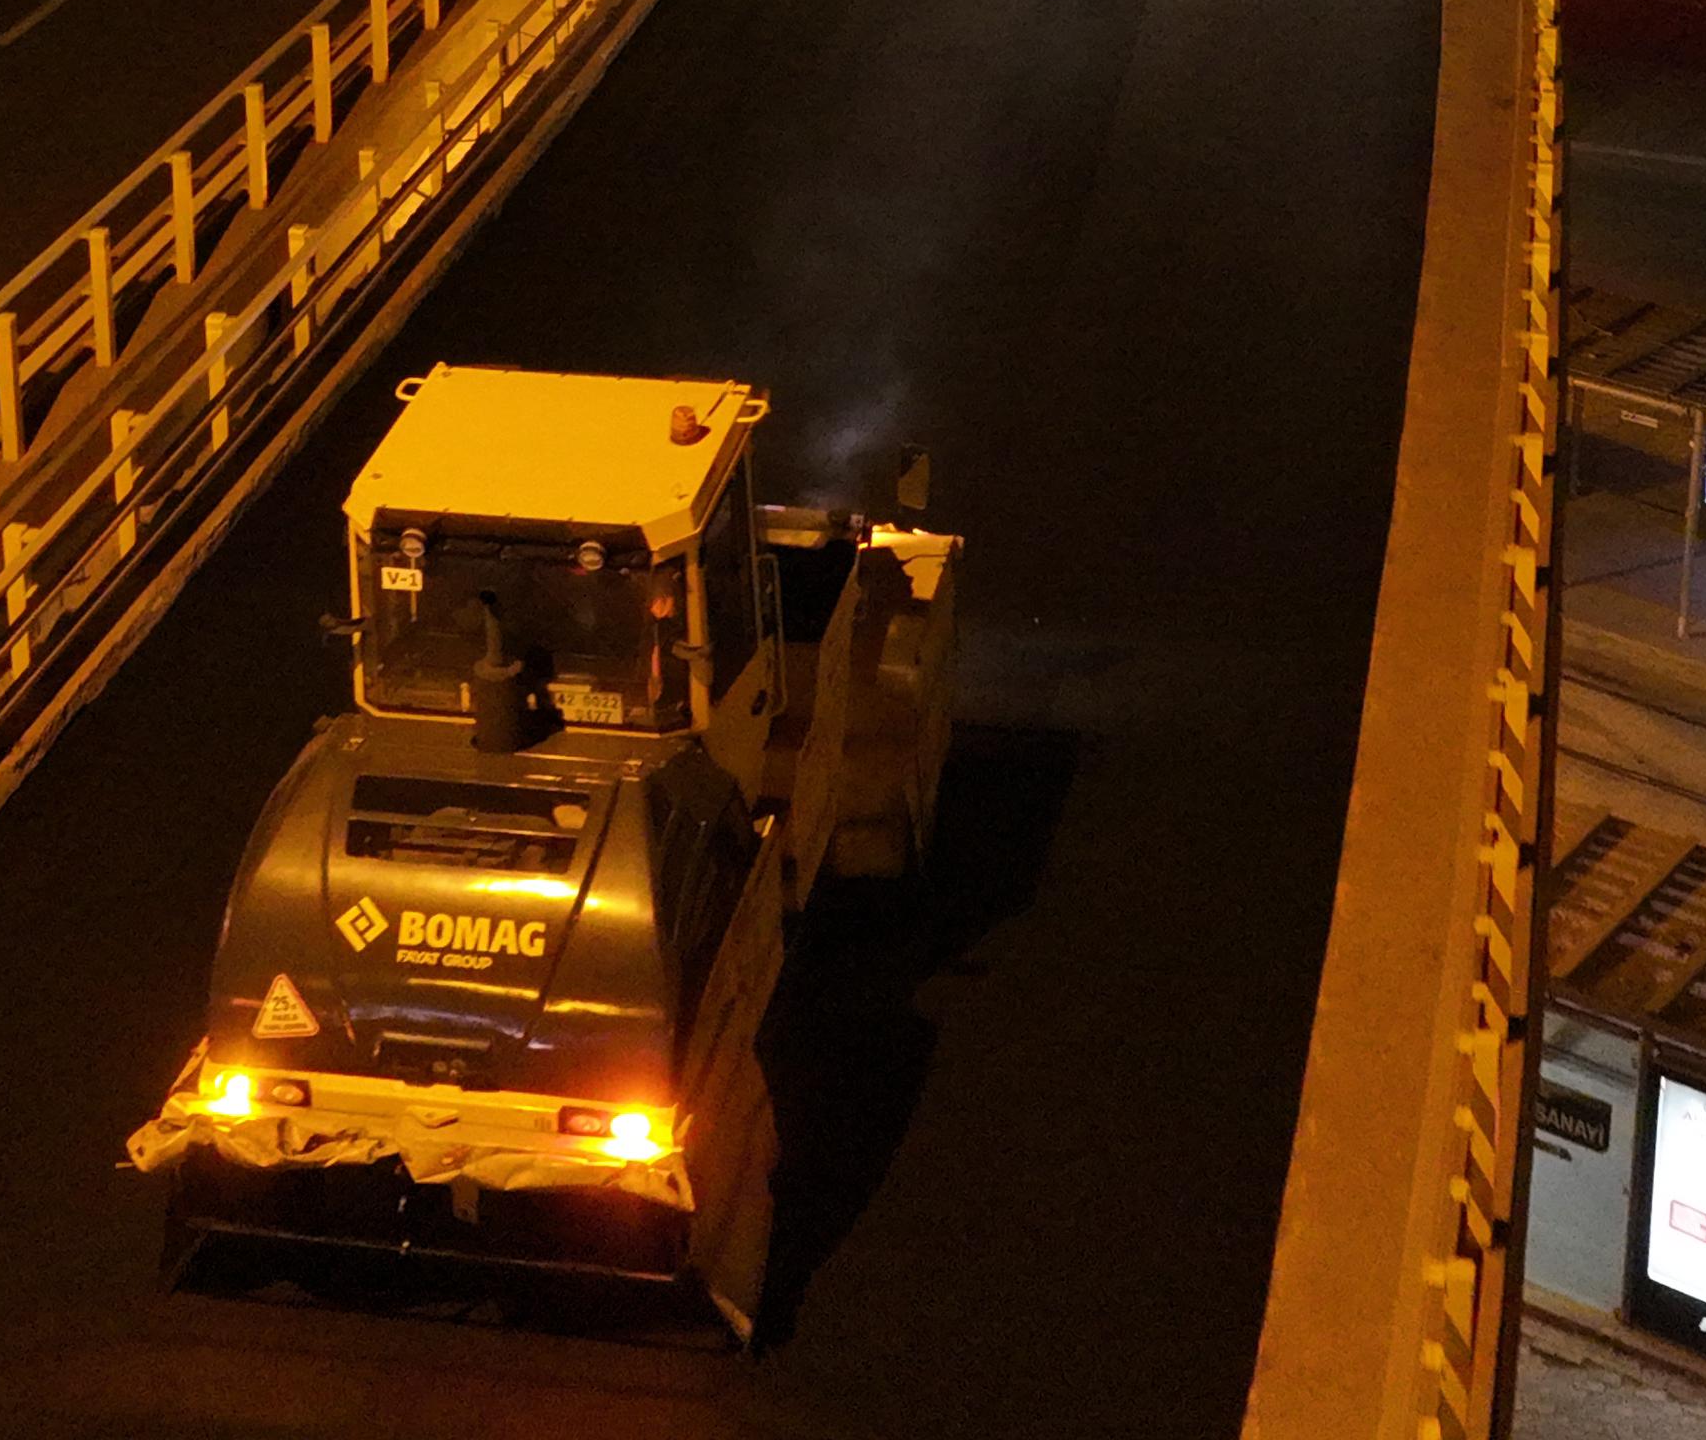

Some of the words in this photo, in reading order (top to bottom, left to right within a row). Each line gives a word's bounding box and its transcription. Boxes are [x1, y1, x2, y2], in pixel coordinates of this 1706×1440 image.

[386, 571, 418, 587] V-1
[398, 910, 546, 957] BOMAG
[396, 949, 441, 965] FAYAT
[442, 953, 493, 970] GROUP
